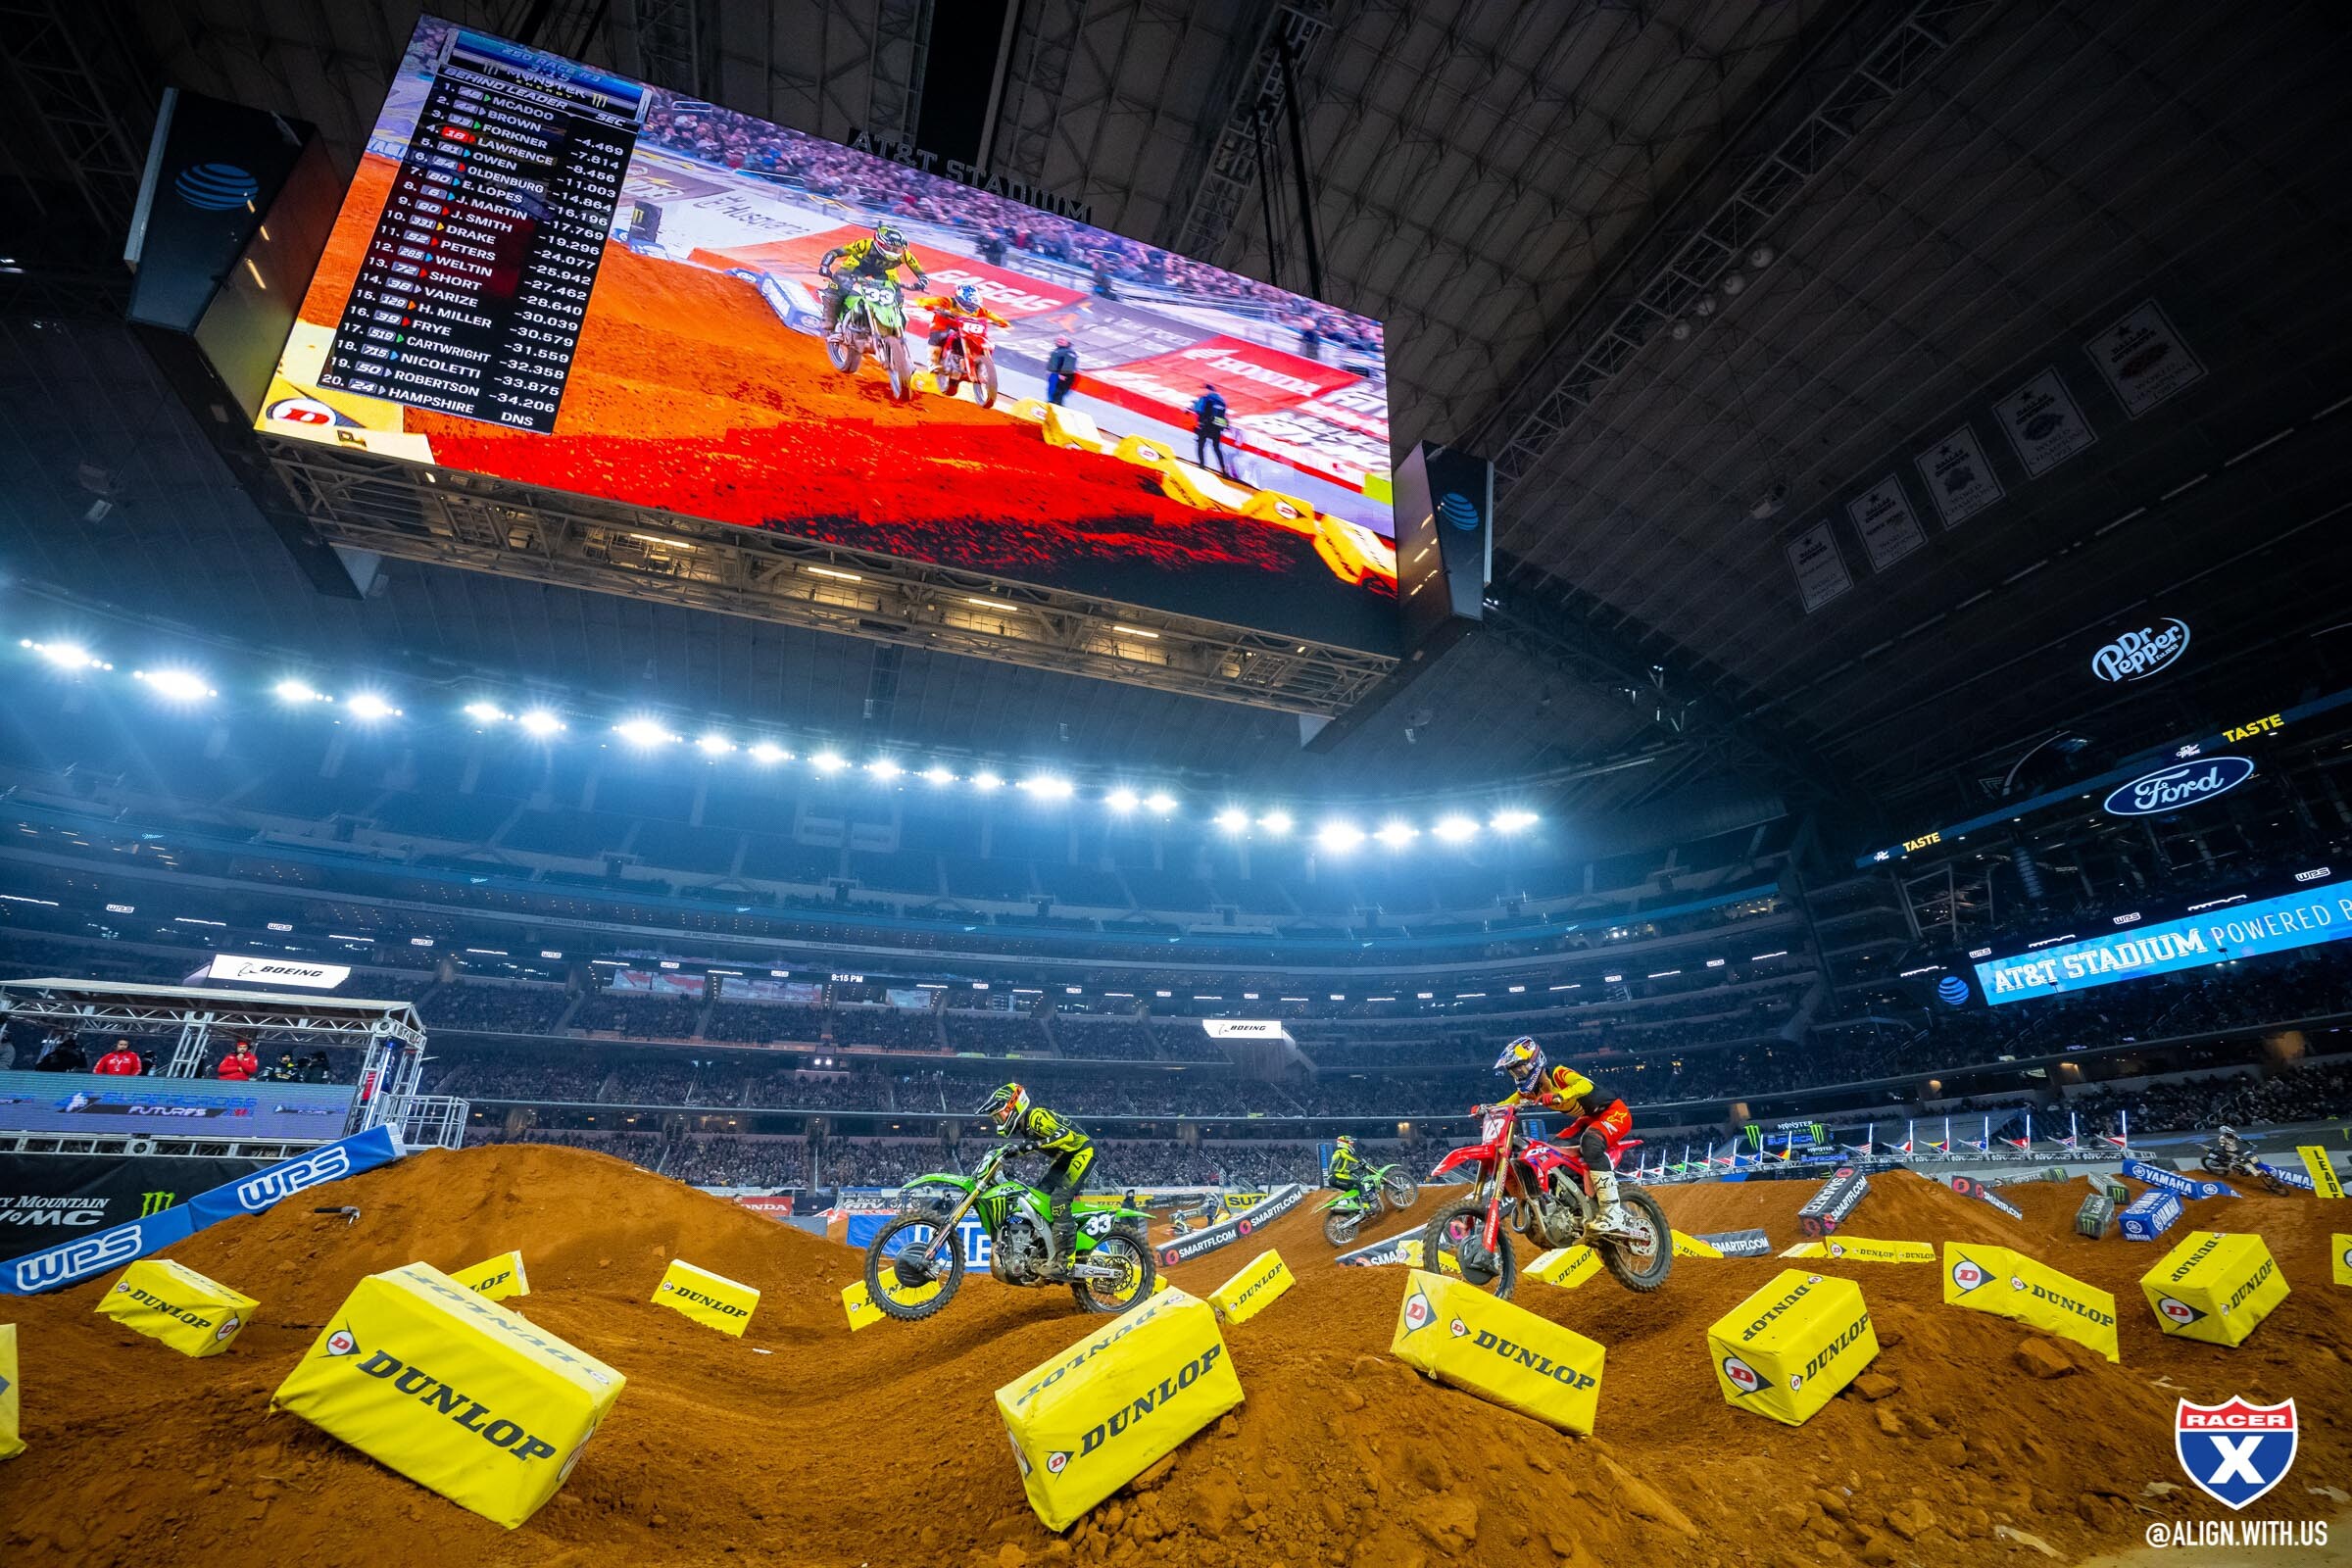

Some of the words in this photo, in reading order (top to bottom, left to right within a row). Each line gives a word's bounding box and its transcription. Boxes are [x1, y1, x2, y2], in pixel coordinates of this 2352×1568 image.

[444, 66, 505, 90] BEHIND
[507, 85, 568, 110] LEADER
[445, 83, 455, 92] 1.
[493, 97, 554, 121] MCADOO
[507, 69, 587, 99] MONSTER
[431, 110, 444, 120] 3.
[483, 123, 548, 149] FORKNER
[570, 151, 619, 170] -7.814
[436, 96, 450, 106] 2.
[488, 110, 541, 132] BROWN
[575, 138, 623, 156] -4.469
[595, 112, 627, 128] SEC
[420, 137, 433, 148] 5.
[472, 152, 517, 171] OWEN
[557, 178, 616, 198] -11.003
[426, 124, 439, 133] 4.
[444, 128, 466, 140] 18
[478, 137, 553, 166] LAWRENCE
[566, 165, 615, 183] -8.456
[411, 166, 422, 176] 7.
[462, 180, 474, 191] E.
[477, 184, 522, 203] LOPES
[548, 206, 608, 226] -16.196
[415, 152, 428, 163] 6.
[467, 167, 544, 193] OLDENBURG
[553, 192, 612, 213] -14.864
[398, 196, 412, 207] 9.
[416, 201, 440, 213] 90
[450, 211, 463, 220] J.
[466, 214, 513, 232] SMITH
[539, 235, 600, 256] -19.296
[403, 181, 417, 191] 8.
[456, 195, 468, 206] J.
[470, 199, 527, 220] MARTIN
[544, 220, 605, 241] -17.769
[381, 225, 400, 237] 11.
[405, 231, 429, 244] 52
[440, 240, 496, 261] PETERS
[529, 265, 591, 285] -25.942
[387, 210, 406, 221] 10.
[410, 216, 434, 228] 331
[446, 224, 496, 245] DRAKE
[534, 250, 596, 270] -24.077
[369, 257, 388, 269] 13.
[395, 263, 417, 274] 72
[429, 271, 482, 290] SHORT
[519, 295, 582, 316] -28.640
[375, 240, 394, 253] 12.
[399, 247, 423, 260] 285
[436, 255, 493, 277] WELTIN
[524, 280, 587, 301] -27.462
[364, 272, 382, 285] 14.
[387, 278, 412, 291] 38
[424, 286, 478, 308] VARIZE
[514, 311, 578, 331] -30.039
[862, 286, 895, 304] 33
[351, 306, 369, 318] 16.
[374, 311, 400, 323] 39
[412, 319, 452, 336] FRYE
[505, 343, 569, 364] -31.559
[357, 289, 376, 301] 15.
[380, 295, 406, 308] 129
[417, 303, 434, 315] H.
[437, 308, 492, 328] MILLER
[510, 326, 573, 347] -30.579
[337, 339, 357, 352] 18.
[363, 344, 387, 358] 715
[401, 353, 481, 378] NICOLETTI
[494, 375, 560, 396] -33.875
[344, 322, 364, 334] 17.
[368, 327, 394, 341] 519
[407, 336, 491, 363] CARTWRIGHT
[500, 359, 564, 379] -32.358
[331, 356, 351, 368] 19.
[356, 362, 381, 374] 50
[394, 370, 480, 397] ROBERTSON
[489, 392, 555, 413] -34.206
[1204, 356, 1321, 398] HONDA
[321, 373, 344, 387] 20.
[349, 379, 374, 392] 24
[388, 387, 474, 414] HAMPSHIRE
[501, 412, 533, 426] DNS
[2092, 625, 2180, 682] Pepper
[2115, 627, 2153, 657] Dr
[2222, 713, 2285, 743] TASTE
[2134, 766, 2225, 809] Ford
[1902, 832, 1941, 853] TASTE
[2294, 867, 2331, 882] WPS
[106, 904, 135, 914] WPS
[268, 922, 293, 932] WPS
[2112, 912, 2142, 924] WPS
[260, 965, 323, 977] BOEING
[1994, 957, 2059, 995] AT&T
[2060, 927, 2209, 980] STADIUM
[2209, 905, 2331, 948] POWERED
[831, 973, 849, 983] 9:15
[128, 1104, 207, 1117] FUTURES
[1777, 1120, 1813, 1130] MONSTER
[237, 1146, 351, 1210] WPS
[1831, 1176, 1868, 1220] SMARTFI.COM
[2146, 1168, 2192, 1194] YAMAHA
[2278, 1168, 2314, 1189] YAMA
[14, 1196, 110, 1208] MOUNTAIN
[1250, 1190, 1302, 1227] SMARTFI.COM
[1086, 1214, 1113, 1237] 33
[1178, 1229, 1237, 1258] SMARTFI.COM
[1711, 1237, 1770, 1253] SMARTFI.COM
[16, 1224, 143, 1292] WPS
[1558, 1247, 1594, 1282] DUNLOP
[1859, 1248, 1895, 1259] DUNLOP
[2171, 1239, 2220, 1283] DUNLOP
[469, 1270, 511, 1293] LOP
[1237, 1262, 1283, 1305] DUNLOP
[1956, 1269, 1980, 1282] D
[2231, 1258, 2274, 1309] DUNLOP
[129, 1288, 213, 1329] DUNLOP
[674, 1287, 749, 1318] DUNLOP
[1407, 1303, 1426, 1320] D
[1742, 1285, 1811, 1343] DUNLOP
[2031, 1284, 2115, 1327] DUNLOP
[1016, 1306, 1157, 1407] DUNLOP
[1473, 1329, 1595, 1392] DUNLOP
[1805, 1313, 1870, 1382] DUNLOP
[1729, 1365, 1754, 1384] D
[355, 1348, 557, 1461] DUNLOP
[1080, 1343, 1222, 1458] DUNLOP
